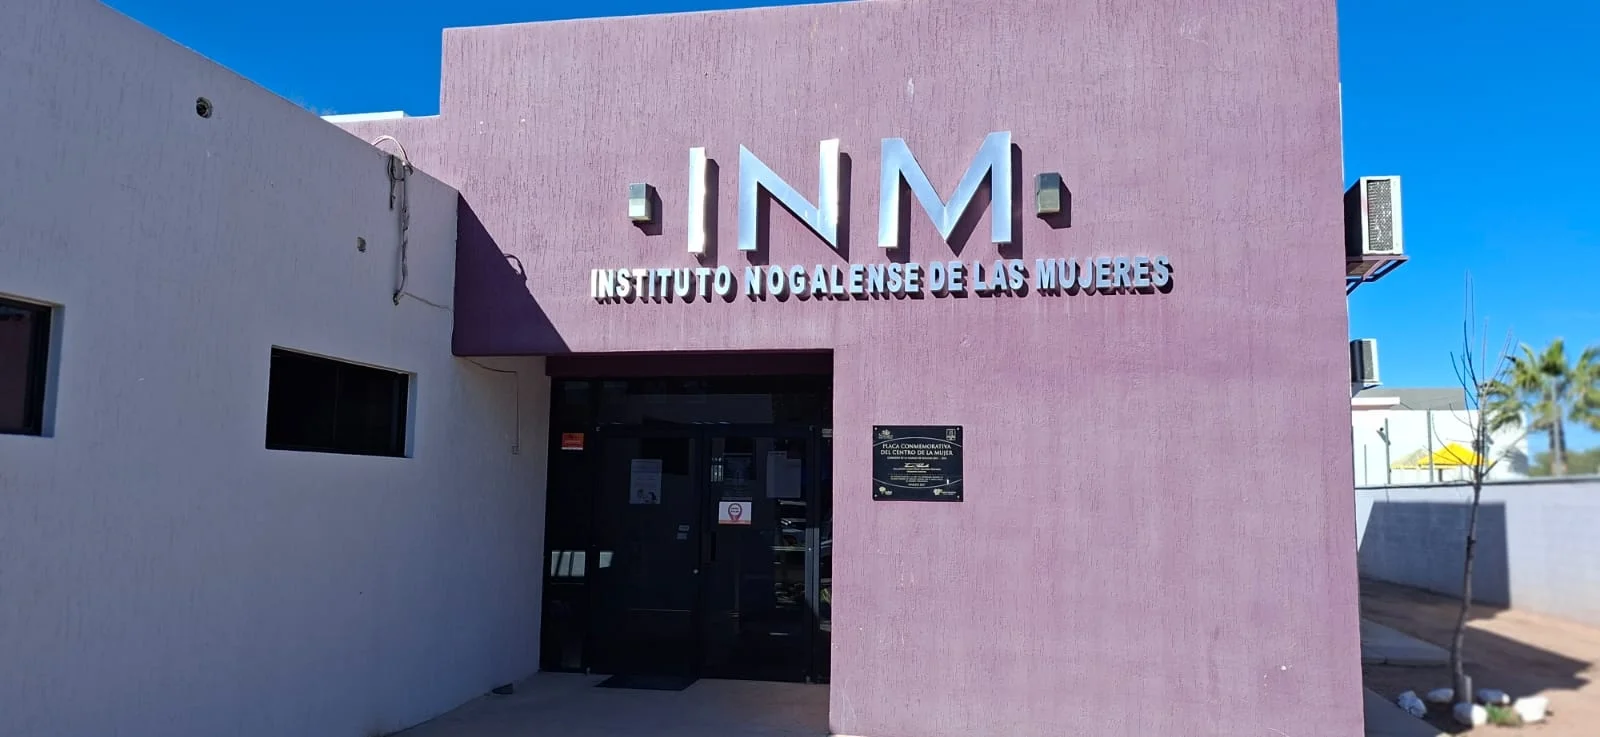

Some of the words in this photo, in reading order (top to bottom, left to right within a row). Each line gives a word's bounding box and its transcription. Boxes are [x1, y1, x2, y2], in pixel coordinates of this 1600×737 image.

[688, 131, 1012, 253] INM
[590, 266, 732, 298] INSTITUTO
[745, 262, 919, 295] NOGALENSE
[931, 261, 963, 292] DE
[974, 259, 1027, 291] LAS
[1036, 255, 1171, 289] MUJERES
